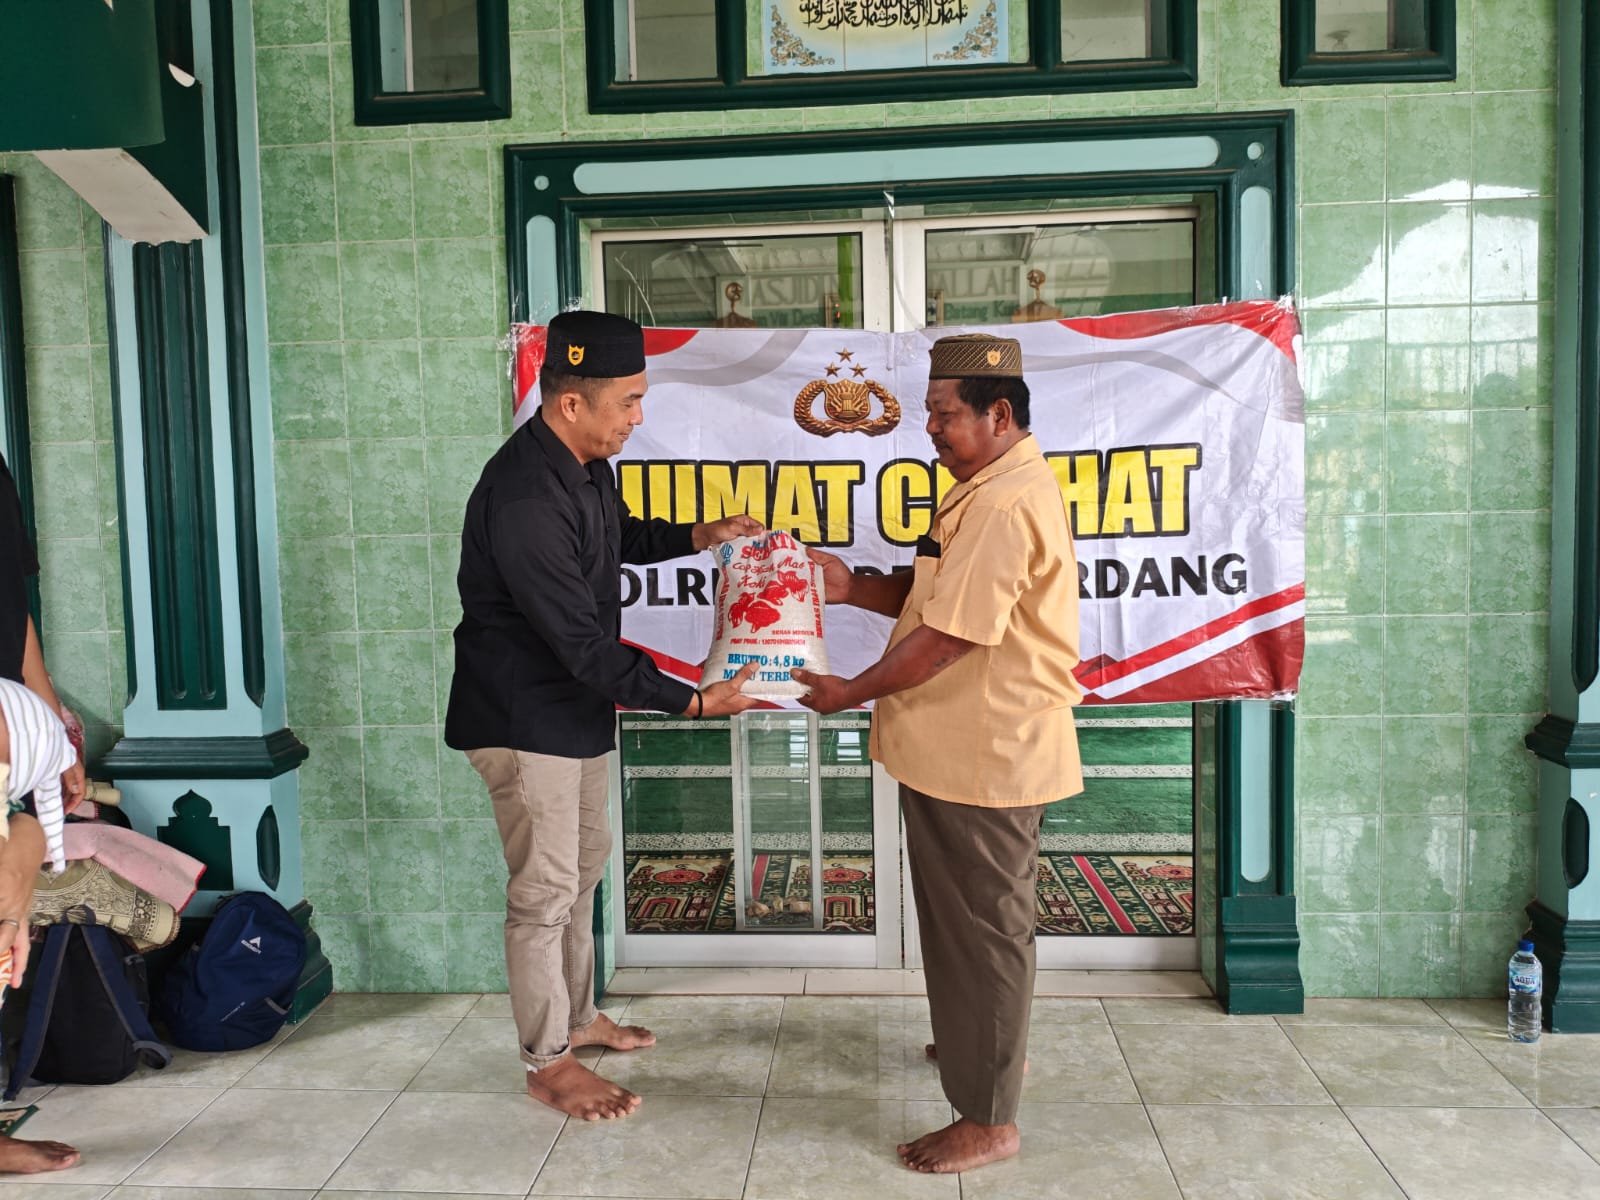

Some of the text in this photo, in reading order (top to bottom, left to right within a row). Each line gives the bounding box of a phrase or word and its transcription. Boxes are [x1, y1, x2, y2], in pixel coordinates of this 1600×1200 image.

[617, 443, 1202, 547] JUMAT CHAT
[1078, 553, 1248, 600] DANG
